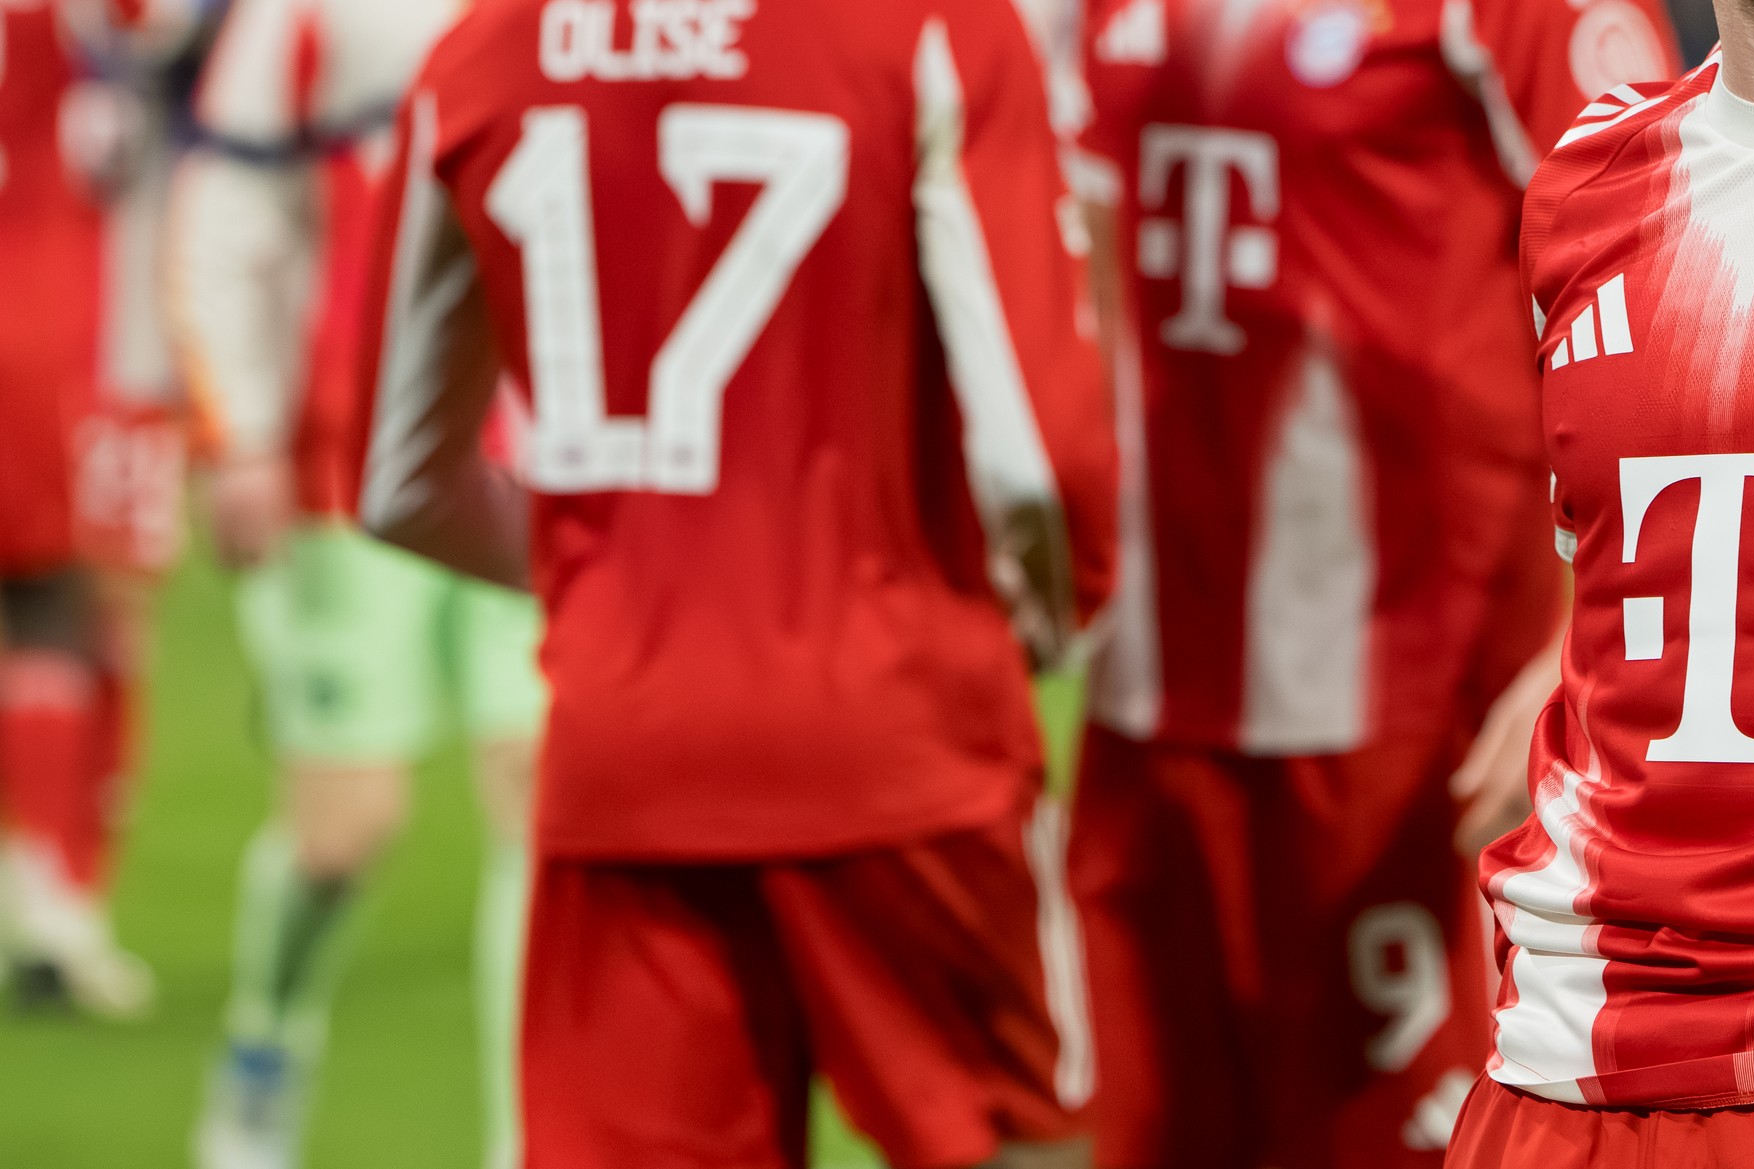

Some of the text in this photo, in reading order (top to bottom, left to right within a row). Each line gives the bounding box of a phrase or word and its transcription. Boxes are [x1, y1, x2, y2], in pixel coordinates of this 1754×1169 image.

[485, 103, 849, 495] 17
[1138, 122, 1280, 355] T
[1348, 901, 1451, 1072] 9
